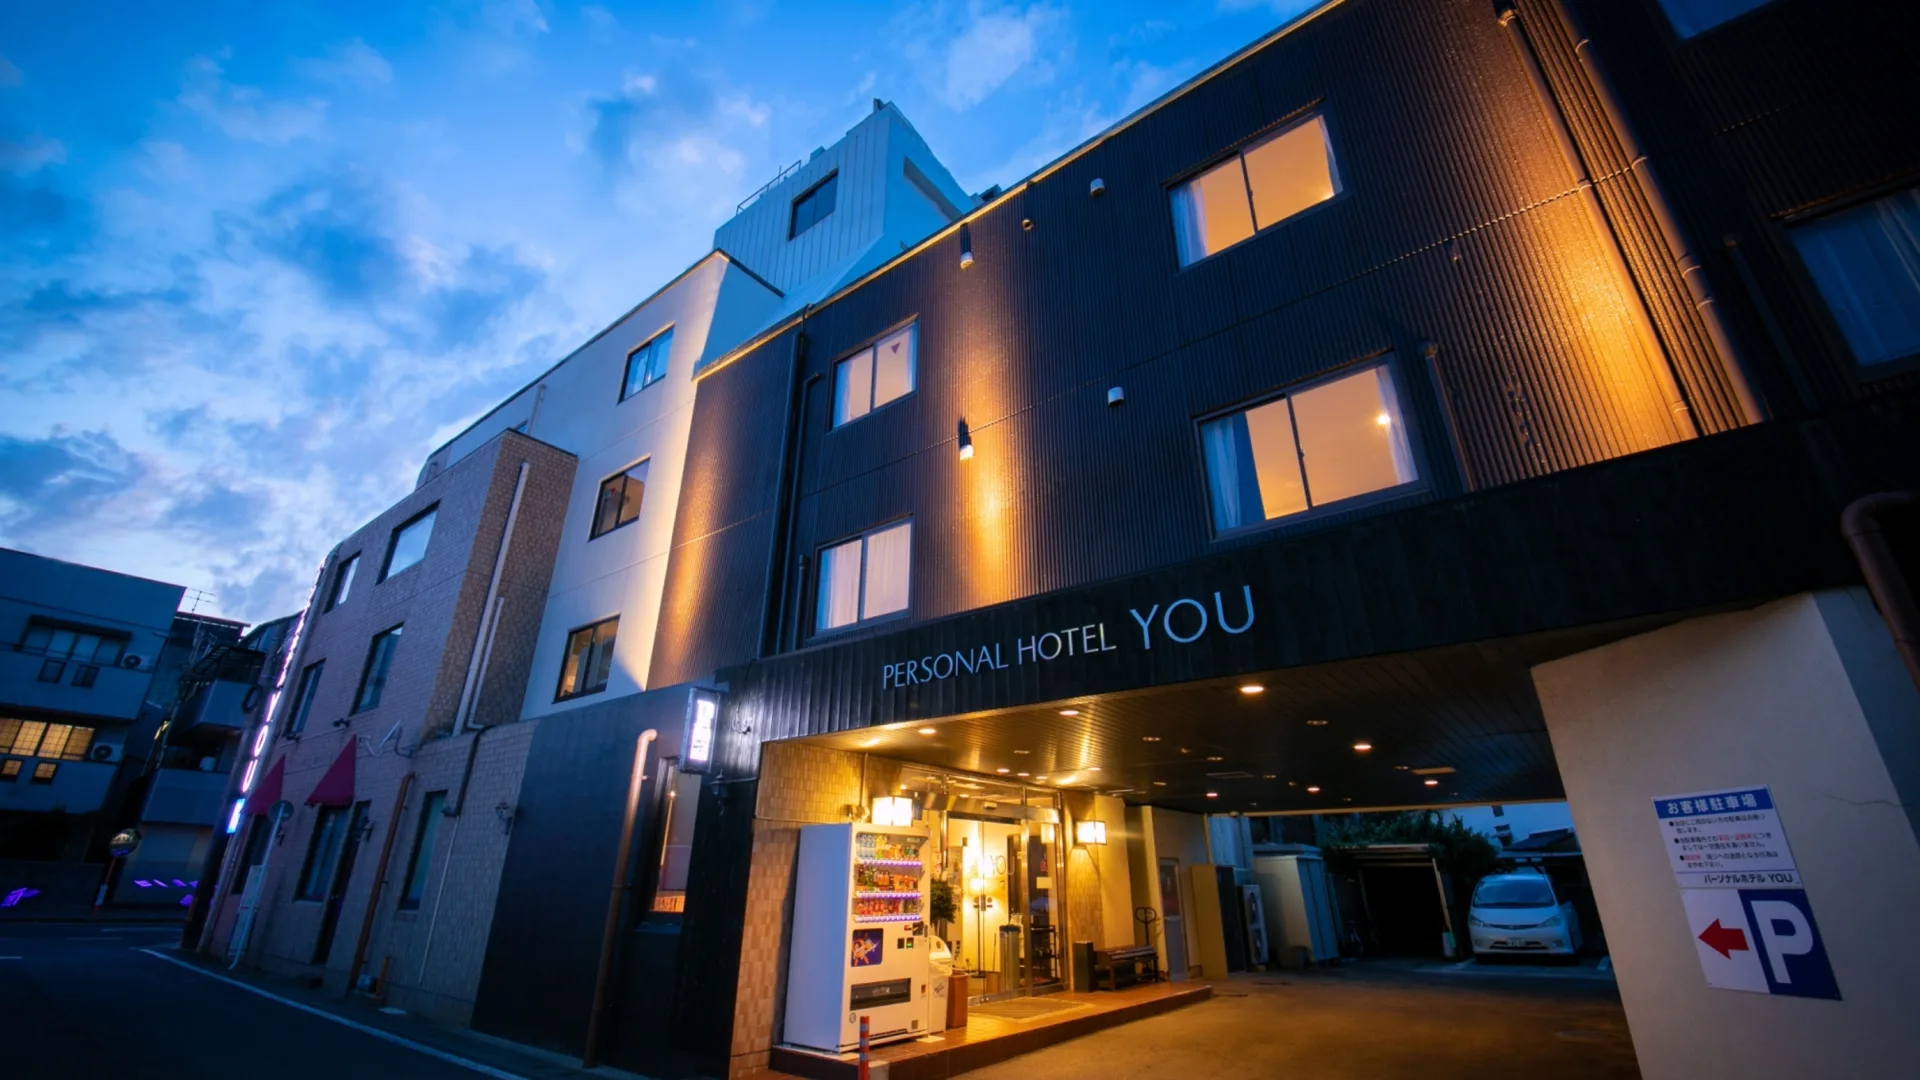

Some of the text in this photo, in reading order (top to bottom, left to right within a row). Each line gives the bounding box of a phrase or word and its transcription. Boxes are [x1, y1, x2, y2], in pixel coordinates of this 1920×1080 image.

[883, 585, 1255, 690] PERSONAL HOTEL YOU
[1667, 793, 1757, 815] お客様駐車場
[1704, 873, 1794, 884] パーソナルホテル YOU
[1750, 899, 1814, 984] P
